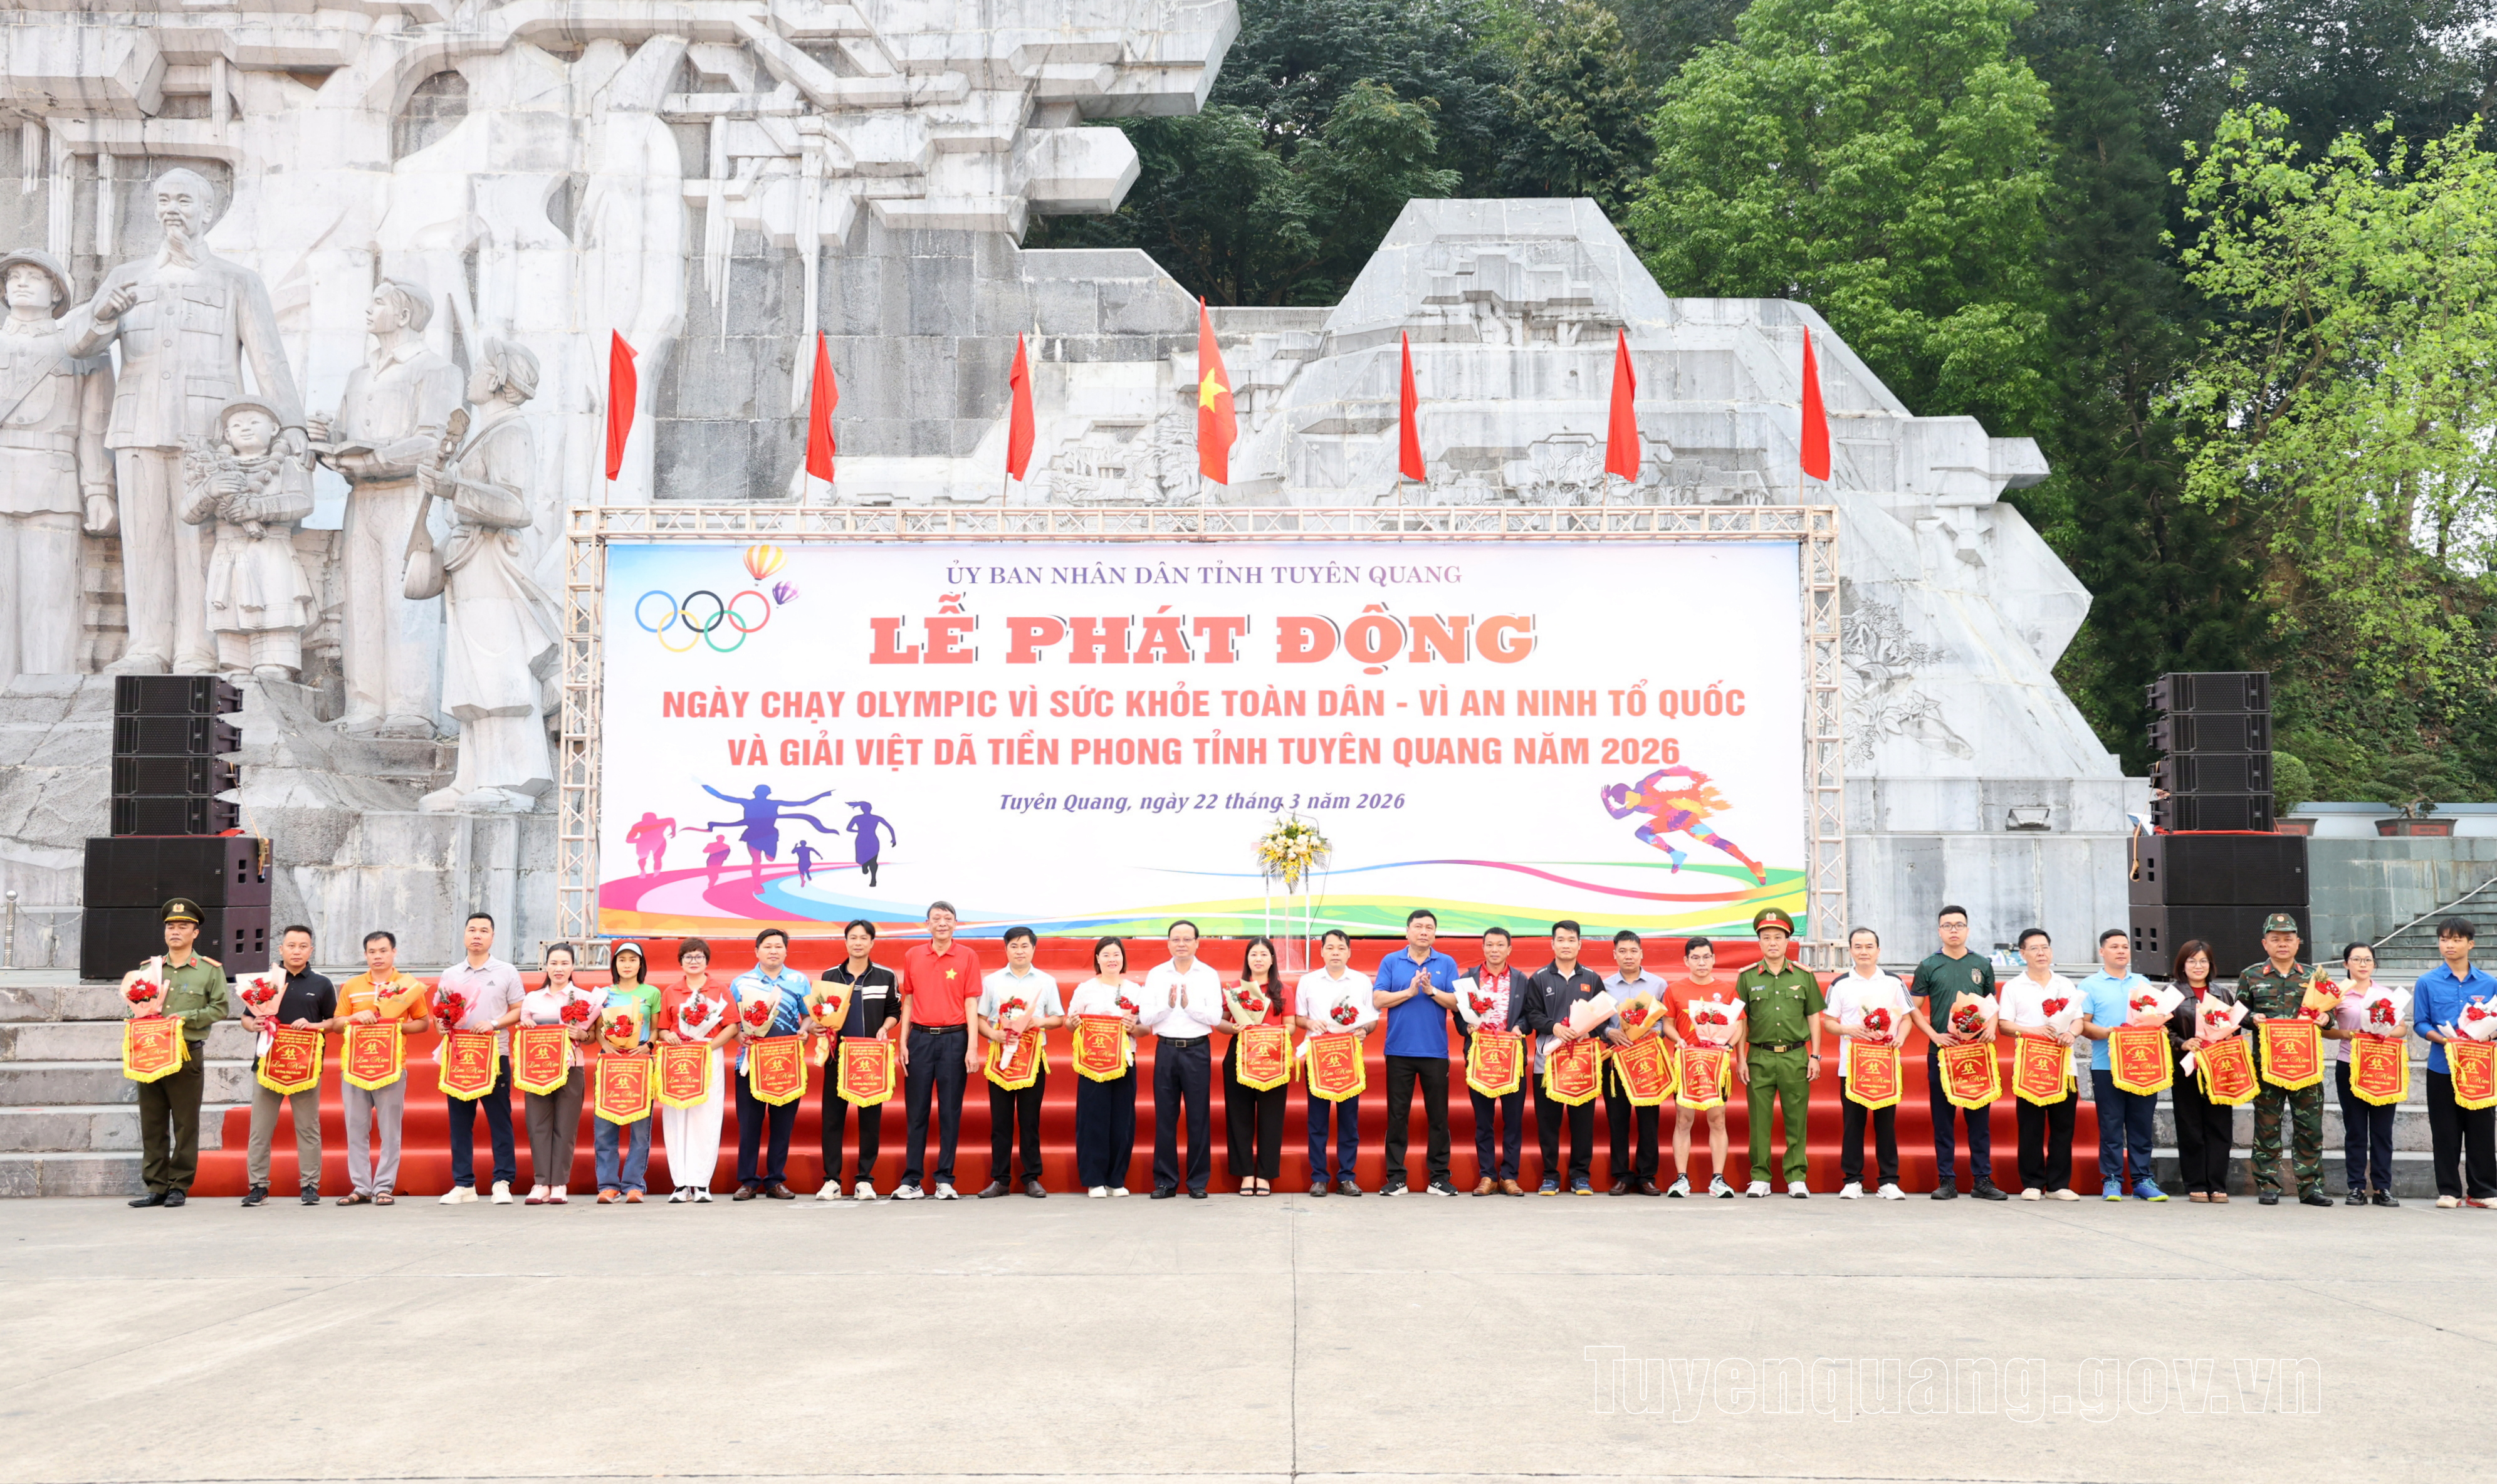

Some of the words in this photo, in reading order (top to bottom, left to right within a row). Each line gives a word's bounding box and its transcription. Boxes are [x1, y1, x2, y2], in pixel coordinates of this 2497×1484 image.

[946, 560, 982, 584] ỦY
[990, 567, 1043, 584] BAN
[1051, 561, 1126, 584] NHÂN
[1134, 561, 1190, 584] DÂN
[1197, 560, 1263, 584] TỈNH
[1271, 560, 1361, 583] TUYÊN
[1368, 566, 1462, 587] QUANG
[869, 592, 979, 664] LỄ
[1006, 605, 1250, 664] PHÁT
[1276, 602, 1537, 675] ĐỘNG
[662, 686, 750, 718] NGÀY
[761, 691, 845, 724] CHẠY
[857, 690, 997, 718] OLYMPIC
[1008, 684, 1037, 717] VÌ
[1050, 684, 1114, 718] SỨC
[1126, 681, 1210, 717] KHỎE
[1221, 684, 1306, 717] TOÀN
[1318, 684, 1385, 716] DÂN
[1419, 684, 1448, 716] VÌ
[1460, 689, 1505, 716] AN
[1517, 690, 1596, 716] NINH
[1608, 679, 1648, 716] TỔ
[1659, 679, 1745, 719] QUỐC
[728, 733, 768, 766] VÀ
[780, 729, 844, 766] GIẢI
[856, 733, 923, 772] VIỆT
[934, 733, 977, 765] DÃ
[987, 729, 1059, 765] TIỀN
[1071, 738, 1181, 765] PHONG
[1193, 728, 1267, 765] TỈNH
[1278, 731, 1381, 765] TUYÊN
[1393, 737, 1502, 768] QUANG
[1514, 732, 1589, 765] NĂM
[1601, 738, 1680, 765] 2026
[1000, 792, 1057, 814] Tuyên
[1062, 794, 1132, 814] Quang,
[1139, 792, 1190, 814] ngày
[1193, 793, 1218, 809] 22
[1225, 792, 1284, 813] tháng
[1289, 793, 1301, 810] 3
[1307, 792, 1351, 809] năm
[1356, 793, 1405, 809] 2026
